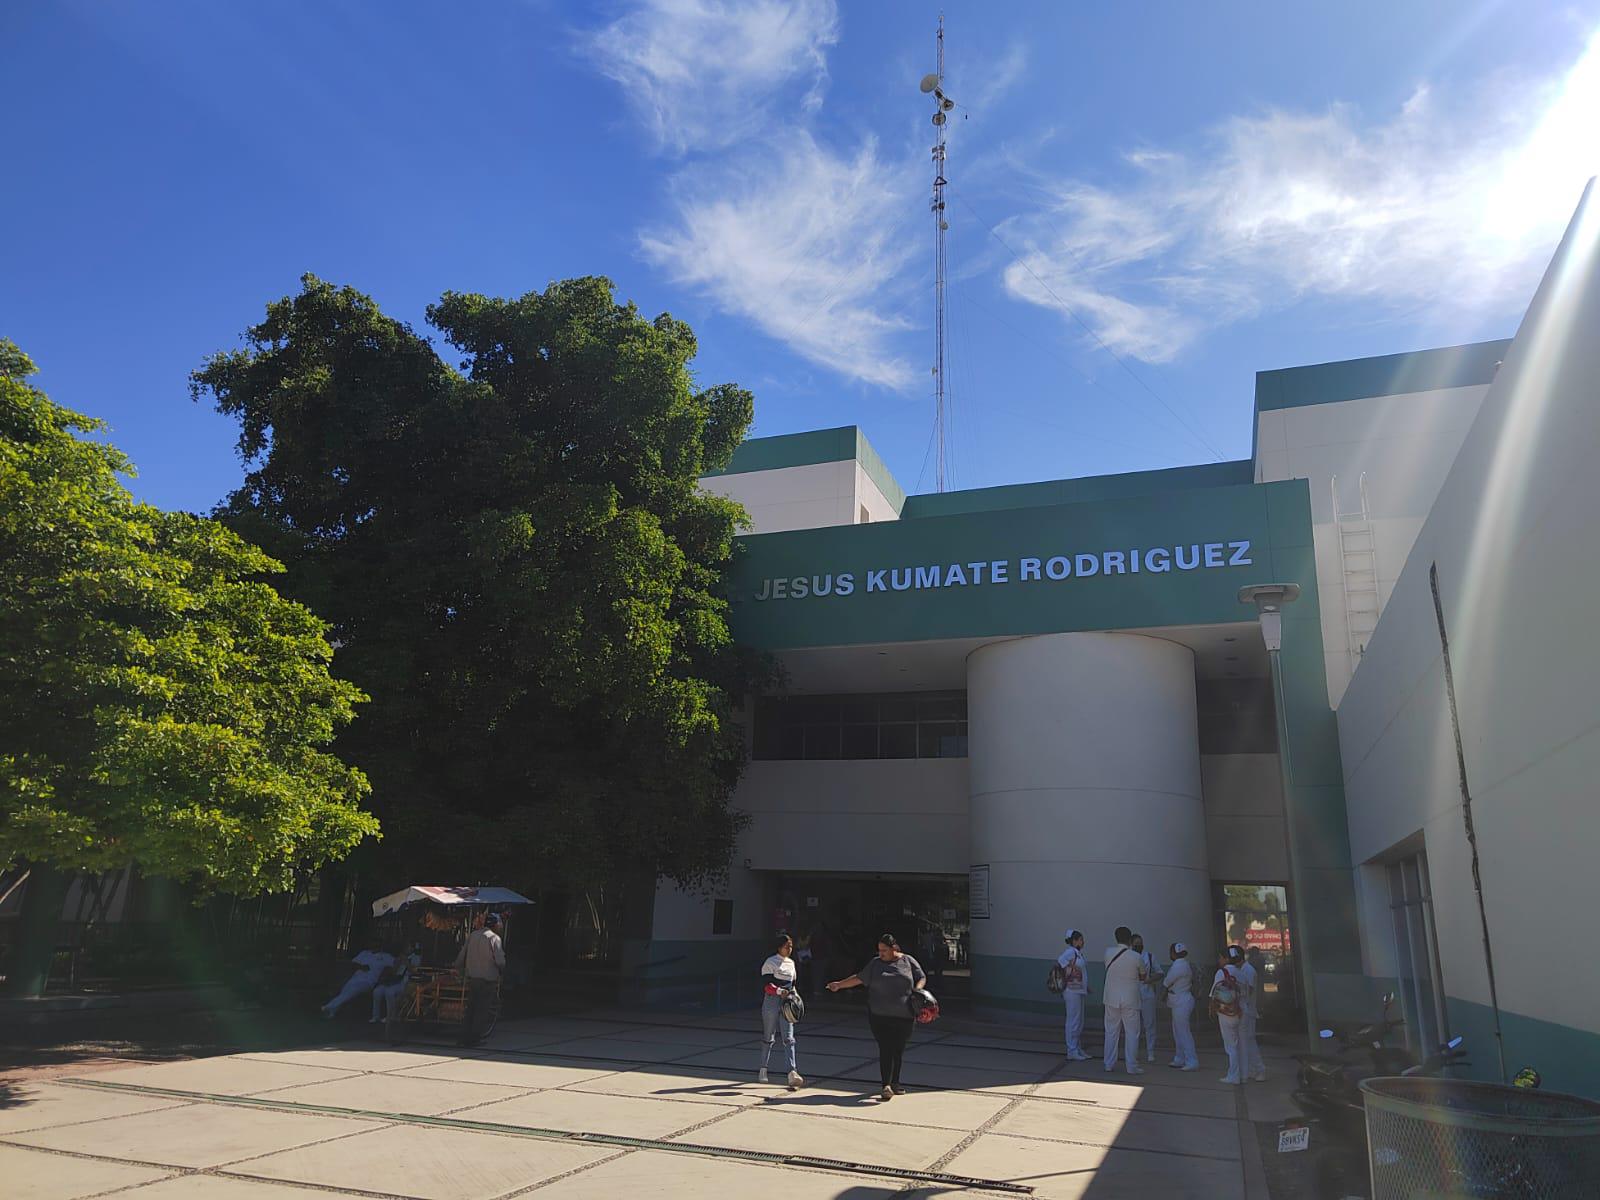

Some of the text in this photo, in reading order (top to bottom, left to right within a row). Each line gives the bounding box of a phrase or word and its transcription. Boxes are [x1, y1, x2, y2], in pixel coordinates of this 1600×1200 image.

[754, 540, 1252, 600] JESUS KUMATE RODRIGUEZ
